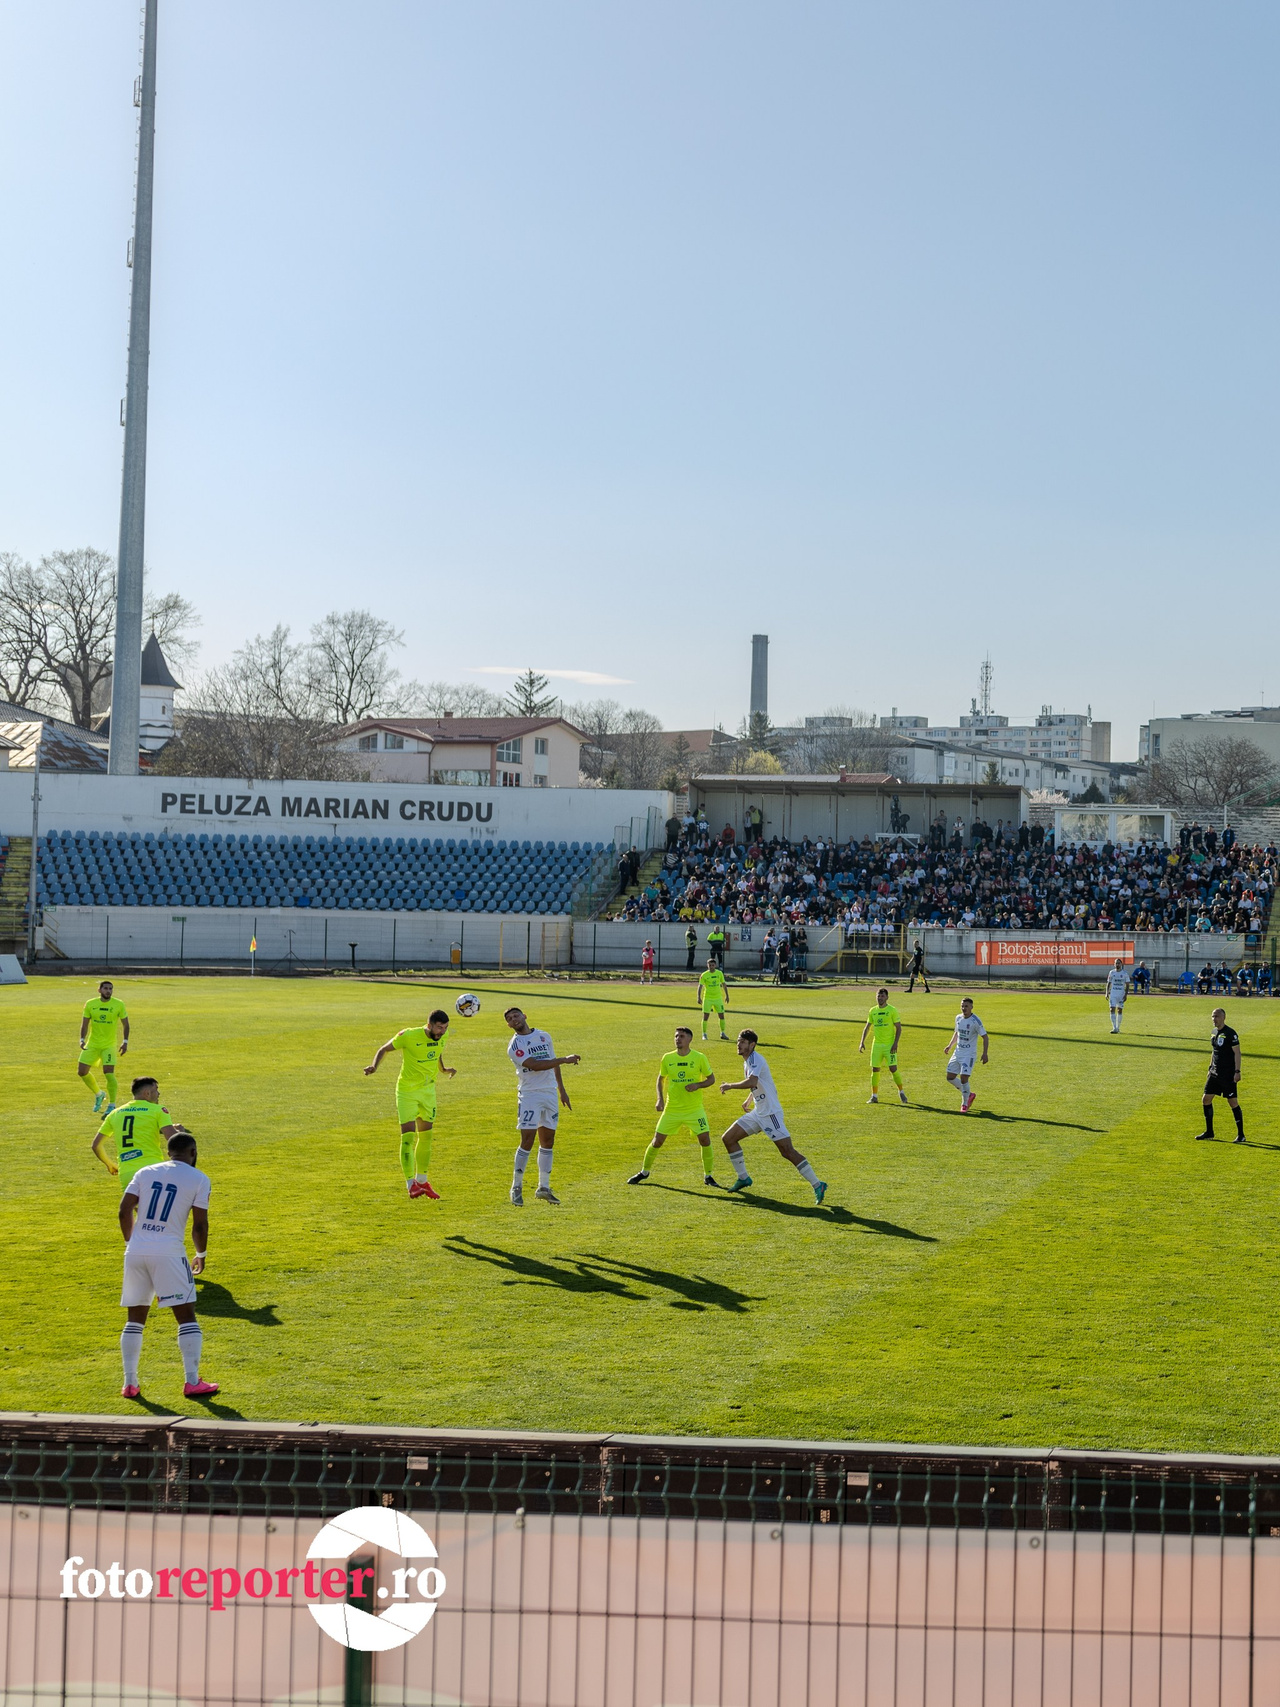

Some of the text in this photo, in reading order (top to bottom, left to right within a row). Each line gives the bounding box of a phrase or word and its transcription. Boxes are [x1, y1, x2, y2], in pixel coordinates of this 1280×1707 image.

[160, 792, 493, 822] PELUZA MARIAN CRUDU
[523, 1110, 535, 1122] 27
[122, 1115, 135, 1148] 2
[146, 1180, 178, 1222] 11
[141, 1223, 166, 1233] REAGY
